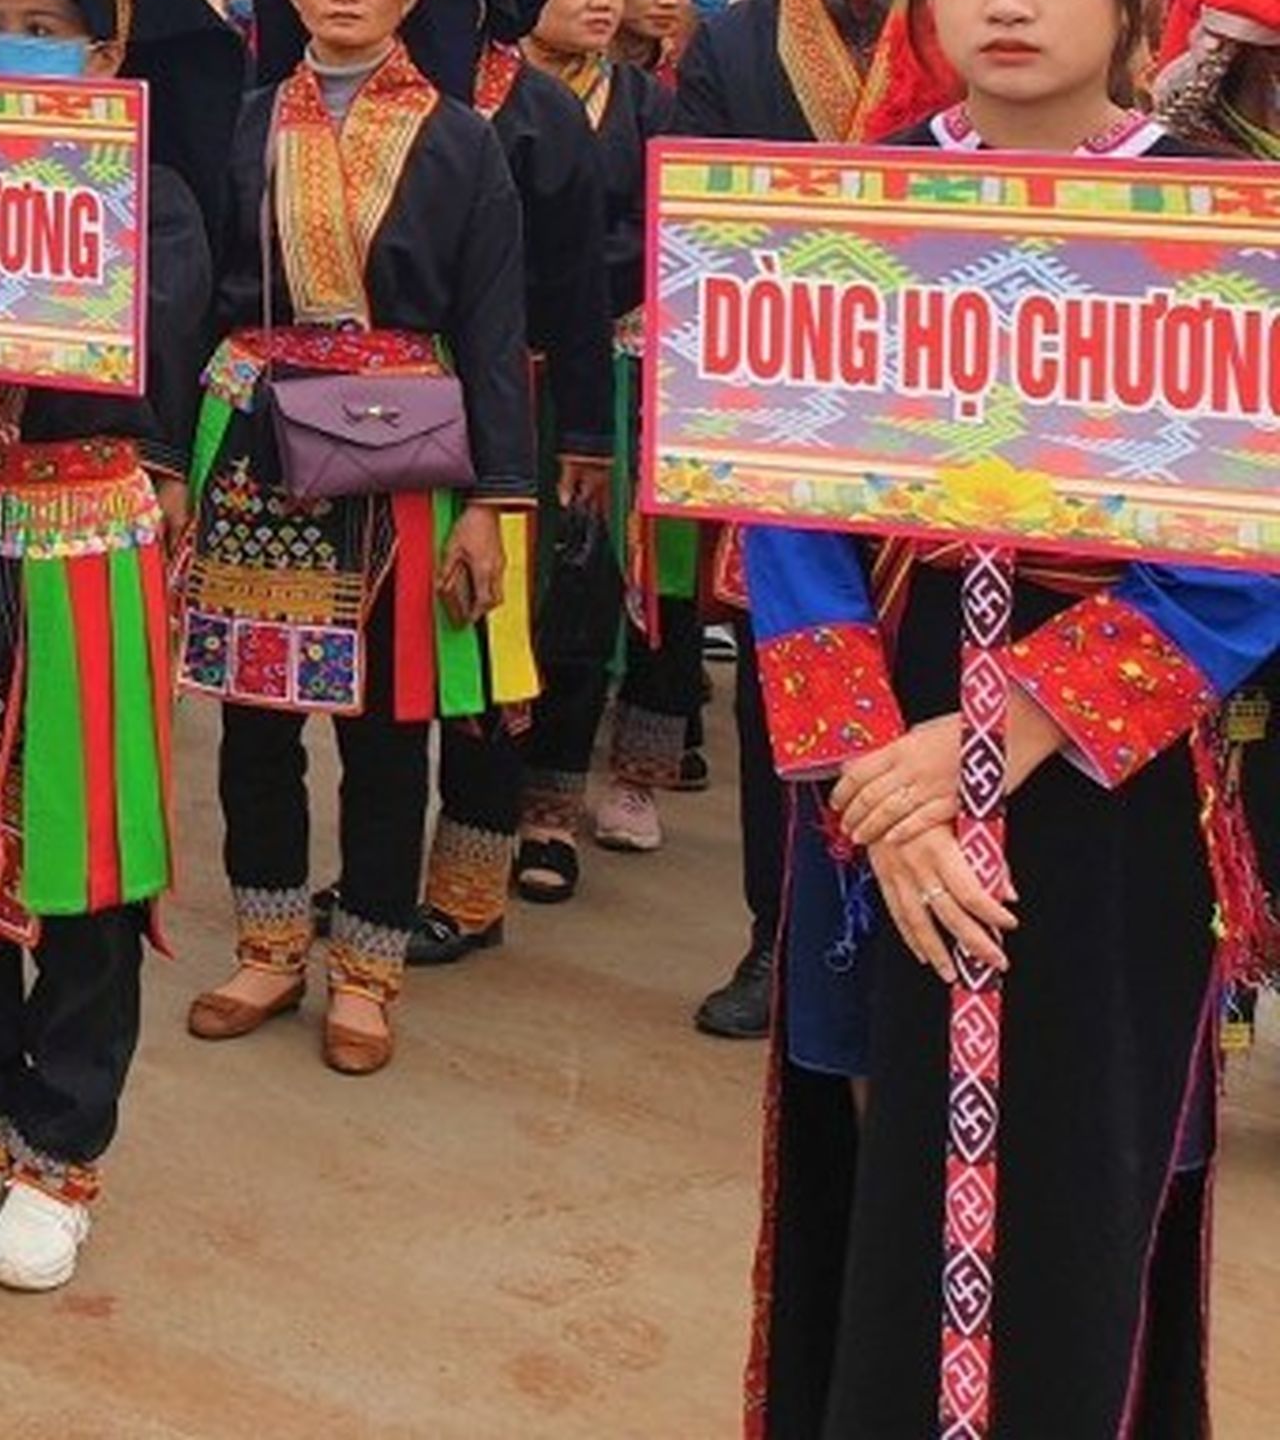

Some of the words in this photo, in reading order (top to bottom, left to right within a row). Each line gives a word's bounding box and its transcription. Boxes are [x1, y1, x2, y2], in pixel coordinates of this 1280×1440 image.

[703, 254, 880, 386] DÒNG
[902, 290, 993, 418] HỌ
[1016, 294, 1280, 416] CHƯƠN
